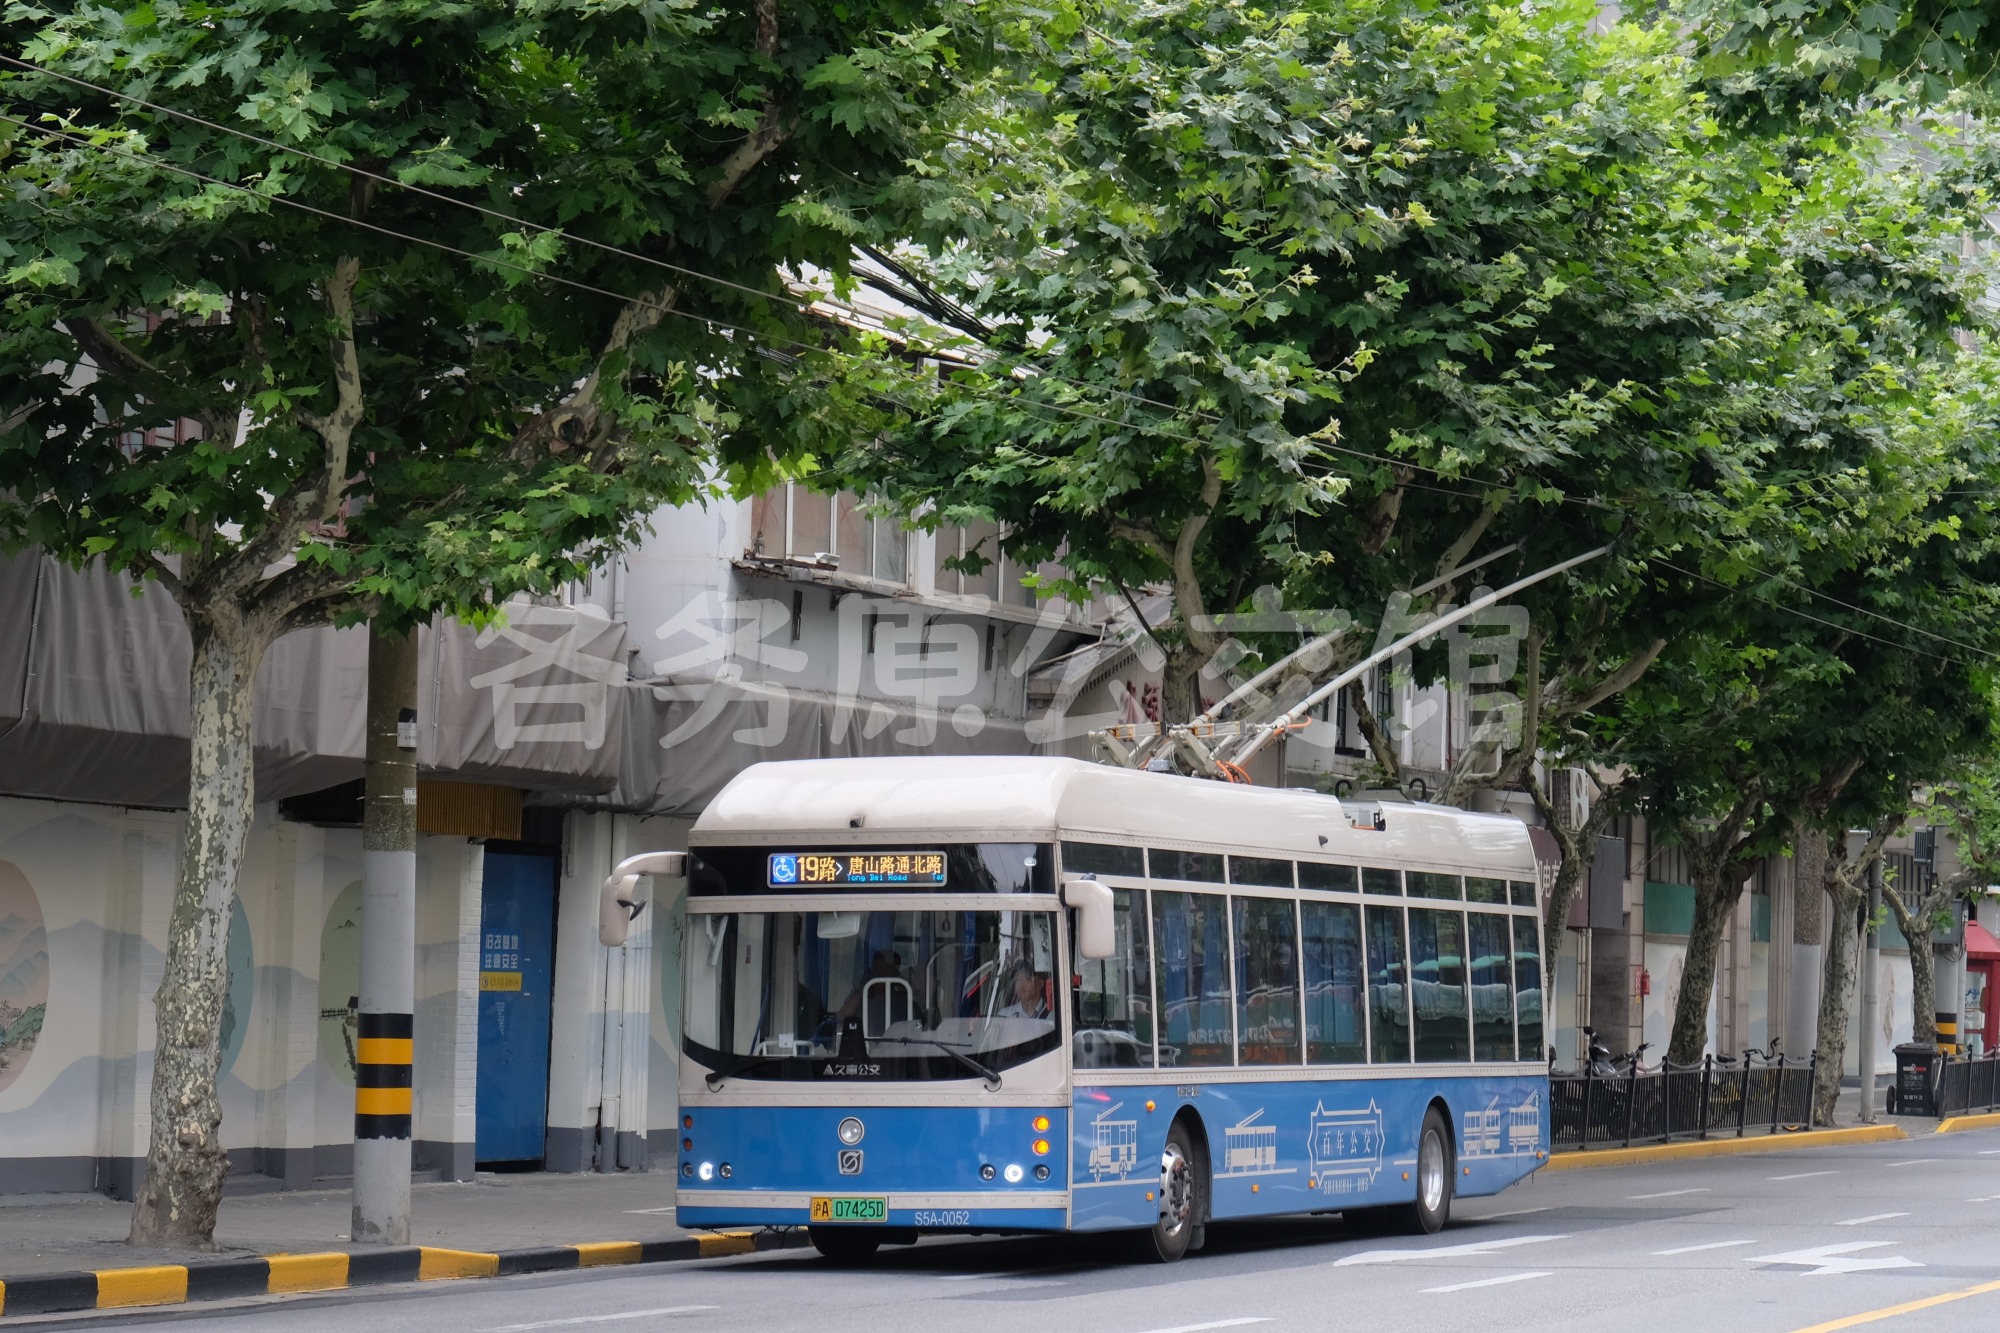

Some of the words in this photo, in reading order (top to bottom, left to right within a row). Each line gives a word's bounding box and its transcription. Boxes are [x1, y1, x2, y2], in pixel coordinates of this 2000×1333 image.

[797, 856, 837, 882] 19路
[848, 855, 942, 875] 唐山路通北路
[846, 873, 866, 882] Tong
[869, 873, 884, 881] Bei
[887, 873, 908, 881] Road
[485, 934, 519, 950] 旧改基地
[484, 953, 518, 969] 注意安全
[1323, 1127, 1371, 1157] 百年公交
[1323, 1178, 1352, 1196] SHANGHAI
[1357, 1177, 1369, 1193] BUS
[914, 1210, 970, 1226] S5A-0052
